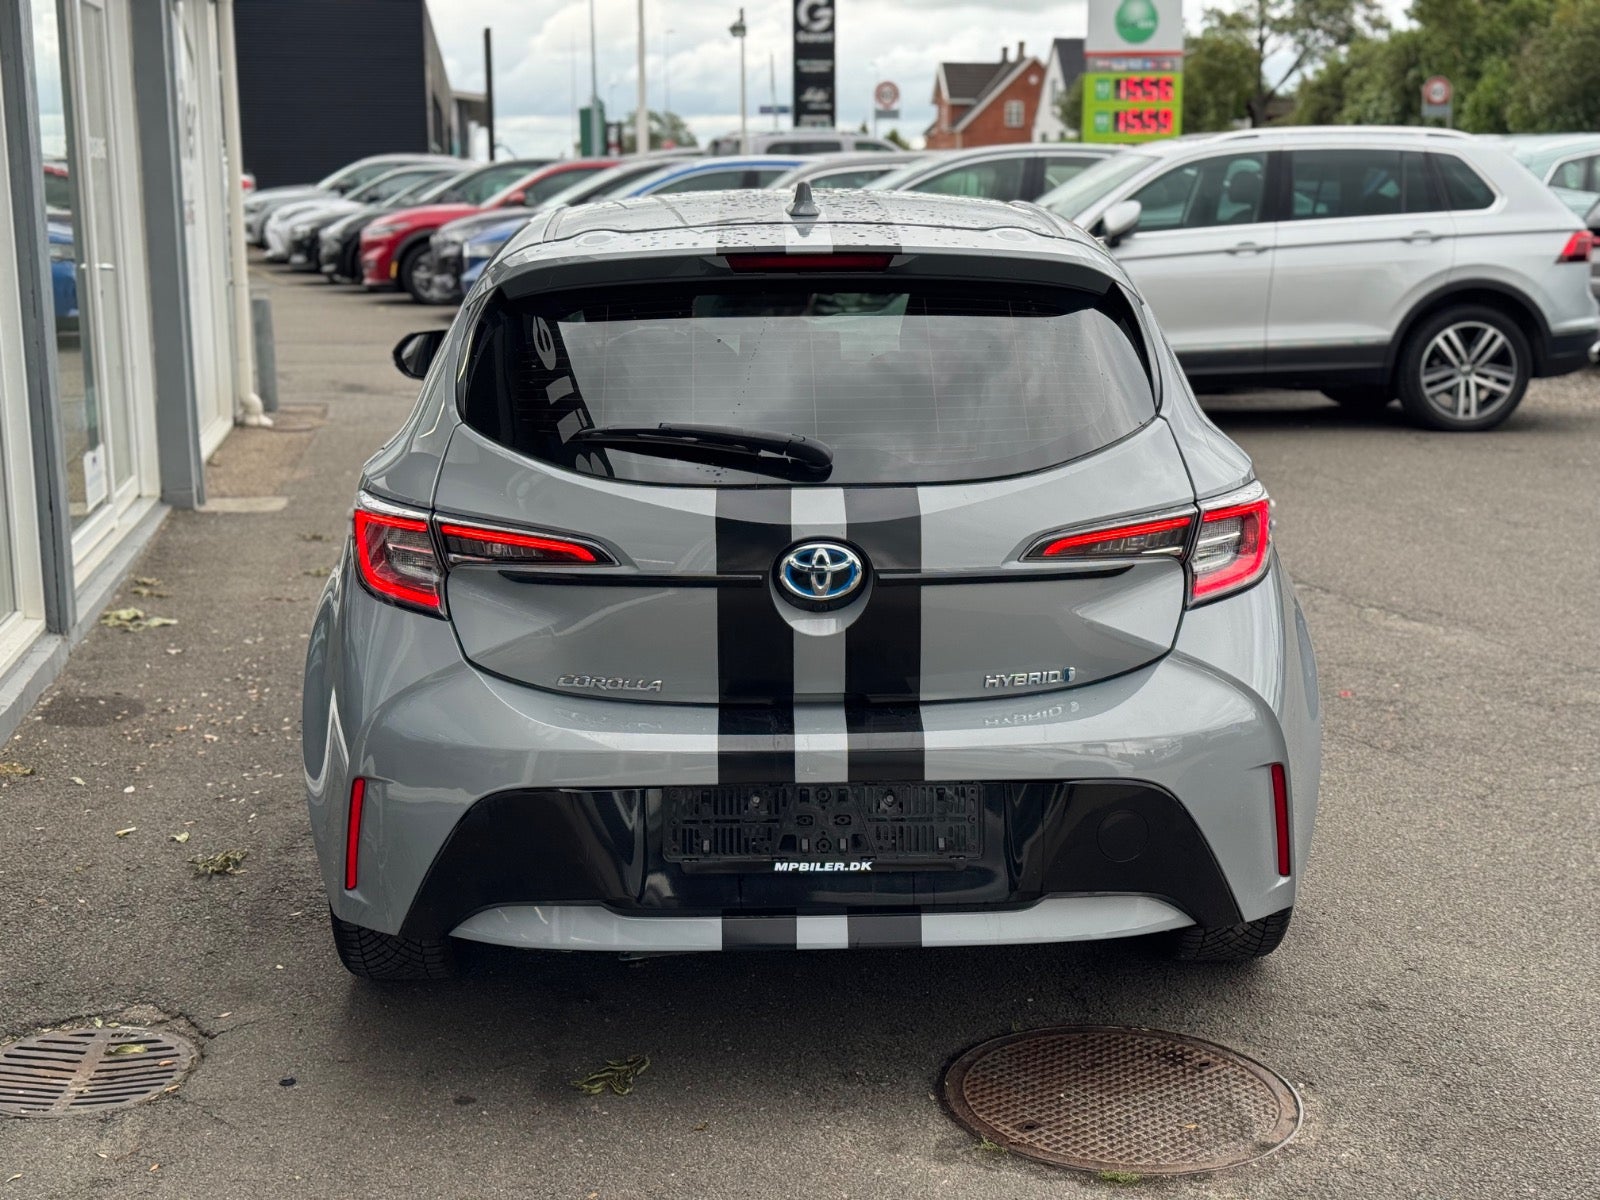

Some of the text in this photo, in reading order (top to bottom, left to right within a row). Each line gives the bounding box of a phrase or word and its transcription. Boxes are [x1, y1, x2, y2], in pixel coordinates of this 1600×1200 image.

[797, 0, 834, 32] G
[557, 674, 663, 692] COROLLA
[984, 671, 1061, 688] HYBRID
[773, 861, 873, 873] MPBILER.DK
